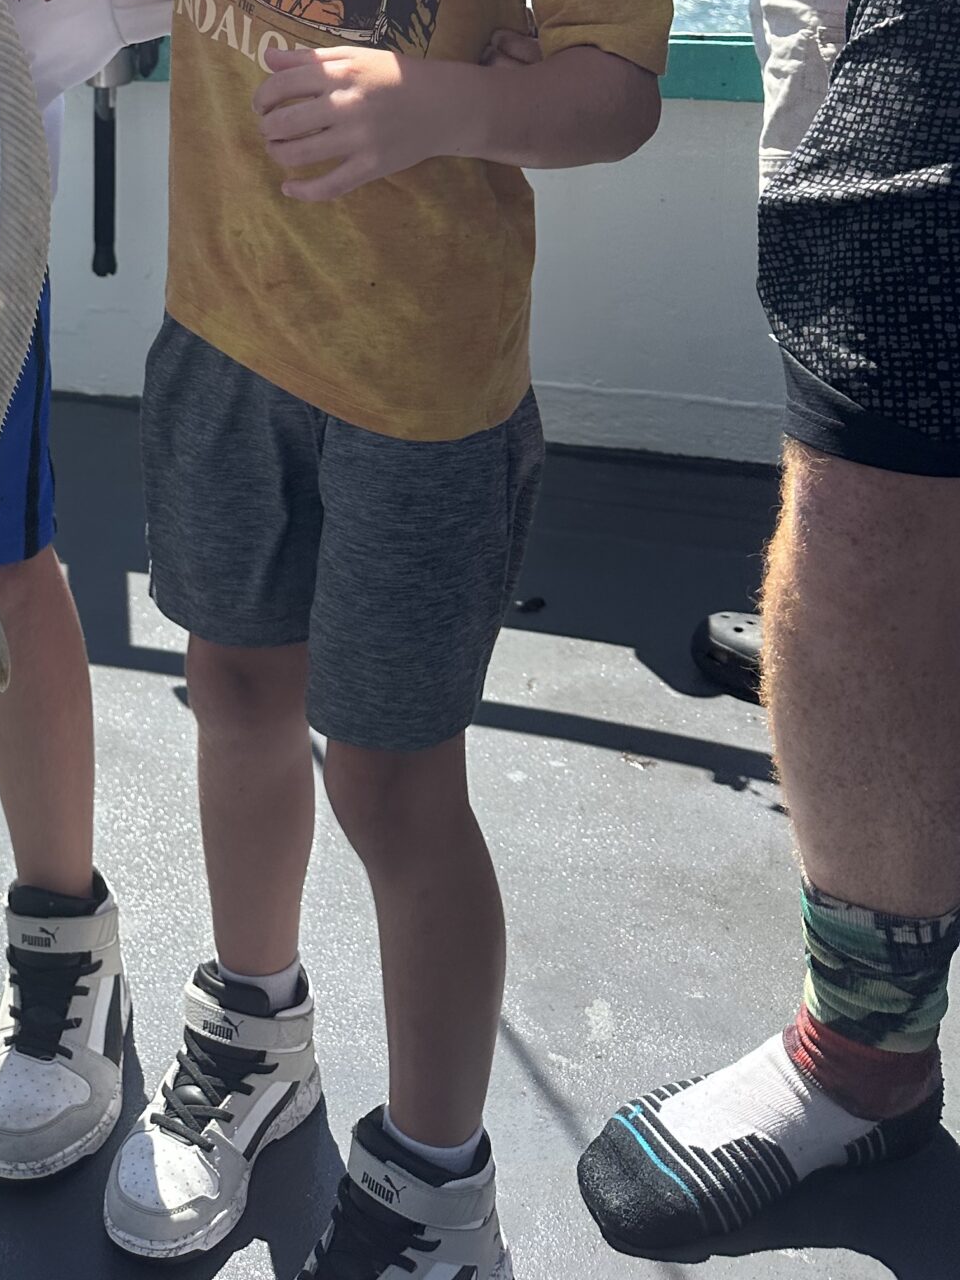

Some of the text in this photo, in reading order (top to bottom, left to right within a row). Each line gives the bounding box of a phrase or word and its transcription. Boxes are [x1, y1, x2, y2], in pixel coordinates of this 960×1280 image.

[21, 933, 51, 948] PUMA
[203, 1019, 233, 1041] PUMA
[361, 1171, 394, 1204] PUMA
